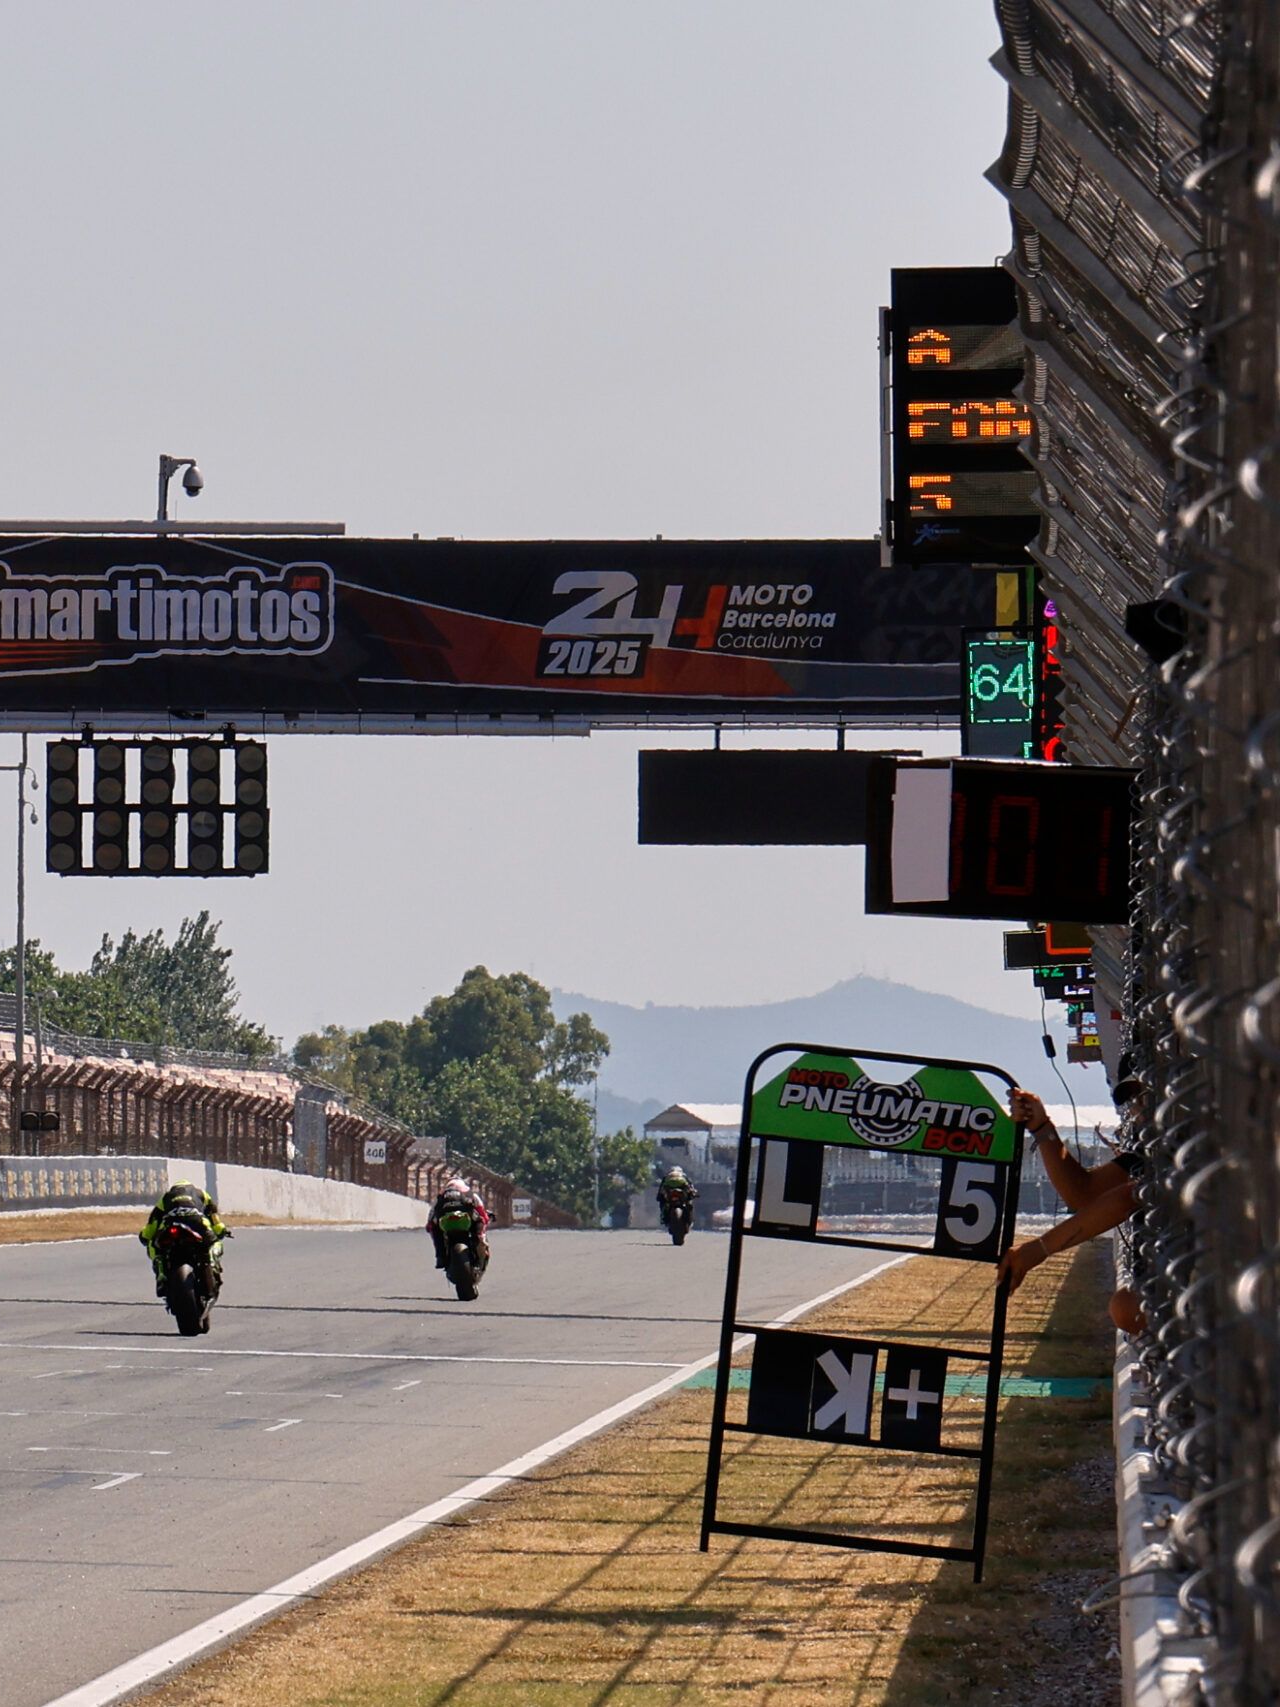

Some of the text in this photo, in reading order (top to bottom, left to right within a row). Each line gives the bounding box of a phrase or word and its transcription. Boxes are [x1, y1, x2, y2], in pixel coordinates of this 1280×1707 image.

[0, 577, 321, 641] martimotos
[728, 584, 813, 606] MOTO
[722, 609, 836, 629] Barcelona
[716, 632, 824, 649] Catalunya
[543, 641, 641, 675] 2025
[973, 663, 1028, 701] 64
[788, 1068, 849, 1088] MOTO
[779, 1084, 995, 1132] PNEUMATIC
[923, 1127, 993, 1155] BCN
[759, 1140, 997, 1244] L 5
